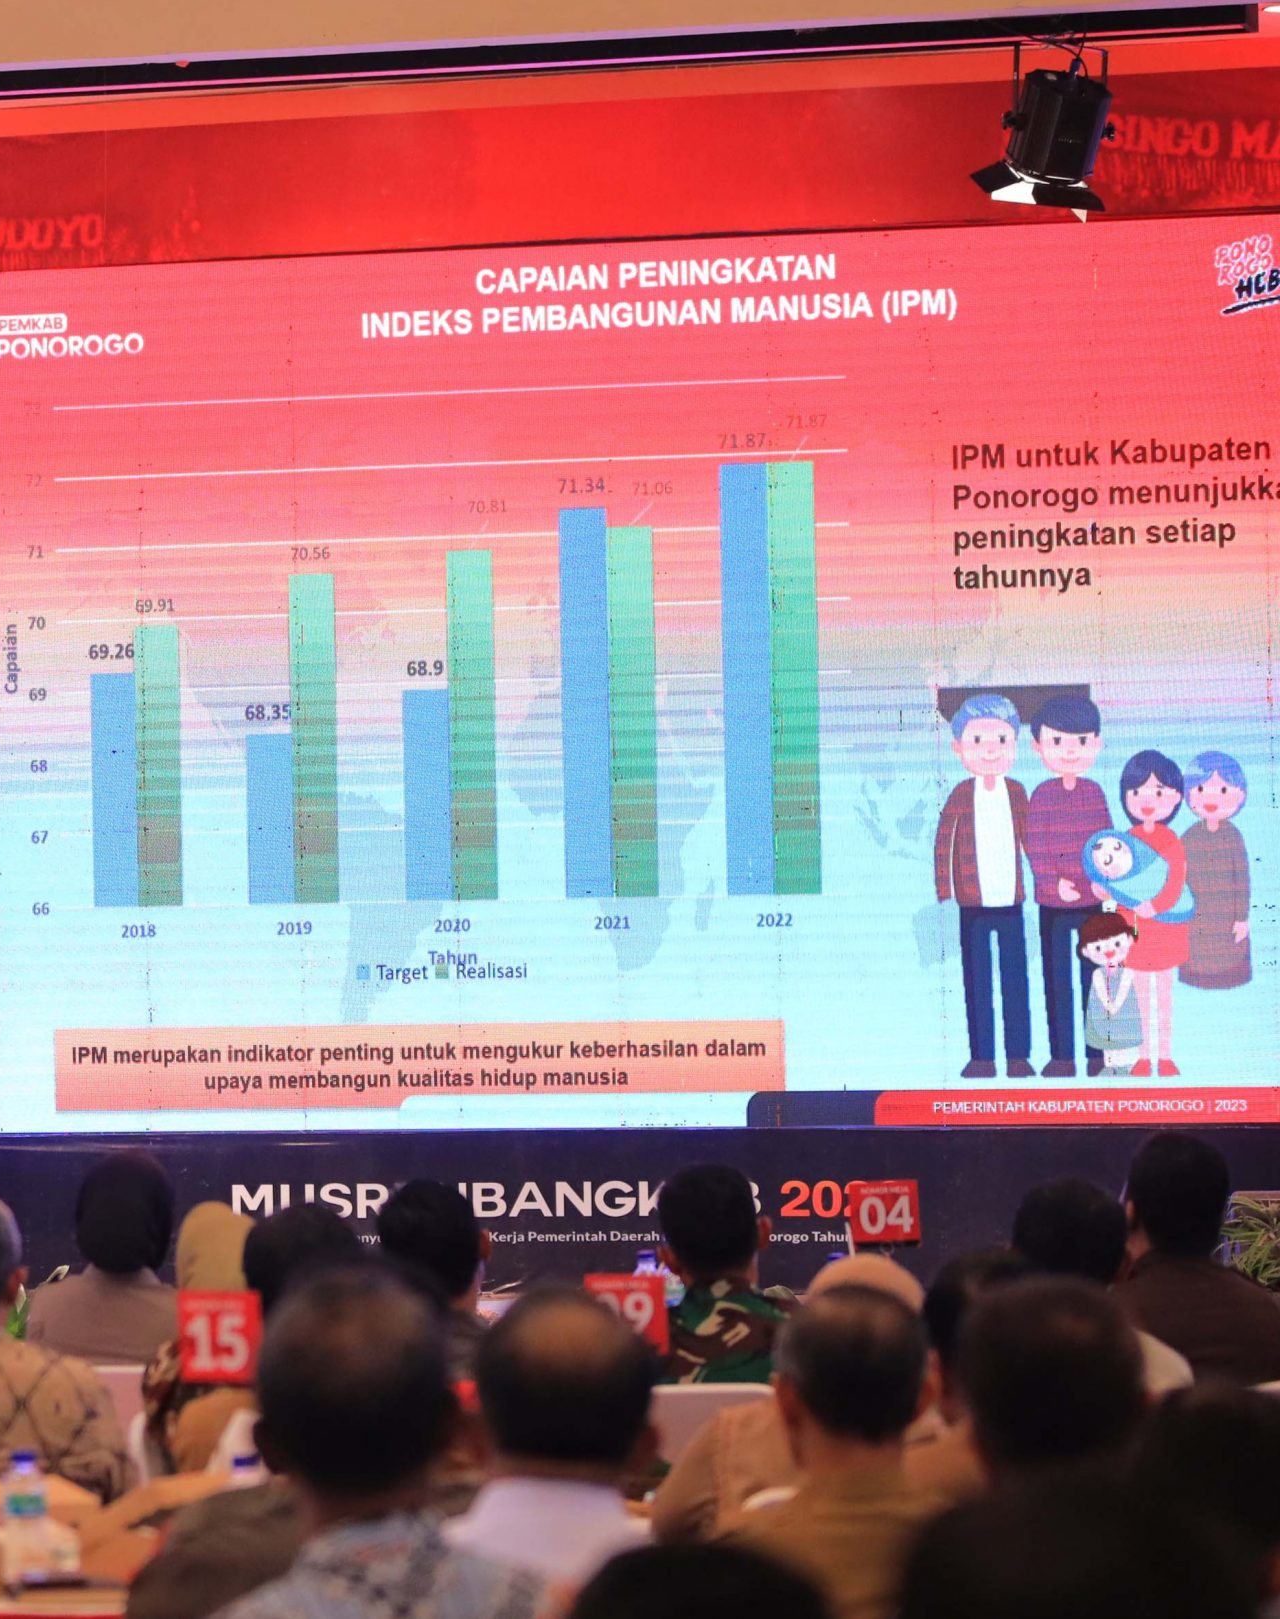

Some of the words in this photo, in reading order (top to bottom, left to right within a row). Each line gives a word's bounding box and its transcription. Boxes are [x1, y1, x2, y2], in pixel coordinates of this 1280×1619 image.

[475, 264, 609, 296] CAPAIAN
[619, 253, 837, 291] PENINGKATAN
[361, 307, 474, 339] INDEKS
[482, 297, 722, 335] PEMBANGUNAN
[730, 291, 873, 324] MANUSIA
[882, 287, 958, 323] (IPM)
[718, 433, 767, 449] 71.87
[952, 443, 1005, 470] IPM
[1016, 440, 1099, 468] untuk
[1110, 437, 1271, 469] Kabupaten
[558, 478, 606, 494] 71.34
[632, 481, 674, 496] 71.06
[953, 483, 1098, 513] Ponorogo
[468, 500, 507, 514] 70.81
[954, 521, 1136, 556] peningkatan
[1146, 518, 1236, 549] setiap
[27, 545, 44, 559] 71
[290, 547, 331, 562] 70.56
[954, 563, 1092, 593] tahunnya
[135, 599, 175, 614] 69.91
[27, 616, 46, 630] 70
[4, 623, 21, 694] Capaian
[88, 644, 135, 660] 69.26
[406, 660, 444, 677] 68.9
[29, 688, 47, 702] 69
[244, 703, 291, 721] 68.35
[30, 760, 48, 774] 68
[31, 831, 49, 845] 67
[32, 902, 50, 916] 66
[434, 918, 471, 933] 2020
[594, 915, 632, 930] 2021
[756, 912, 793, 928] 2022
[121, 924, 157, 939] 2018
[276, 921, 312, 936] 2019
[427, 950, 478, 968] Tahun
[376, 964, 429, 985] Target
[456, 962, 528, 979] Realisasi
[72, 1047, 108, 1064] IPM
[113, 1047, 221, 1068] merupakan
[227, 1044, 314, 1063] indikator
[320, 1043, 393, 1065] penting
[401, 1043, 457, 1061] untuk
[462, 1041, 563, 1064] mengukur
[570, 1040, 698, 1059] keberhasilan
[705, 1039, 767, 1058] dalam
[204, 1075, 263, 1093] upaya
[269, 1070, 391, 1090] membangun
[398, 1069, 474, 1088] kualitas
[480, 1067, 537, 1090] hidup
[543, 1068, 629, 1086] manusia
[933, 1101, 1024, 1114] PEMERINTAH
[1028, 1100, 1115, 1113] KABUPATEN
[1118, 1099, 1205, 1112] PONOROGO
[1214, 1098, 1248, 1112] 2023
[859, 1195, 914, 1236] 04
[488, 1231, 525, 1245] Kerja
[528, 1230, 607, 1243] Pemerintah
[610, 1230, 660, 1242] Daerah
[769, 1233, 809, 1244] orogo
[184, 1315, 250, 1372] 15
